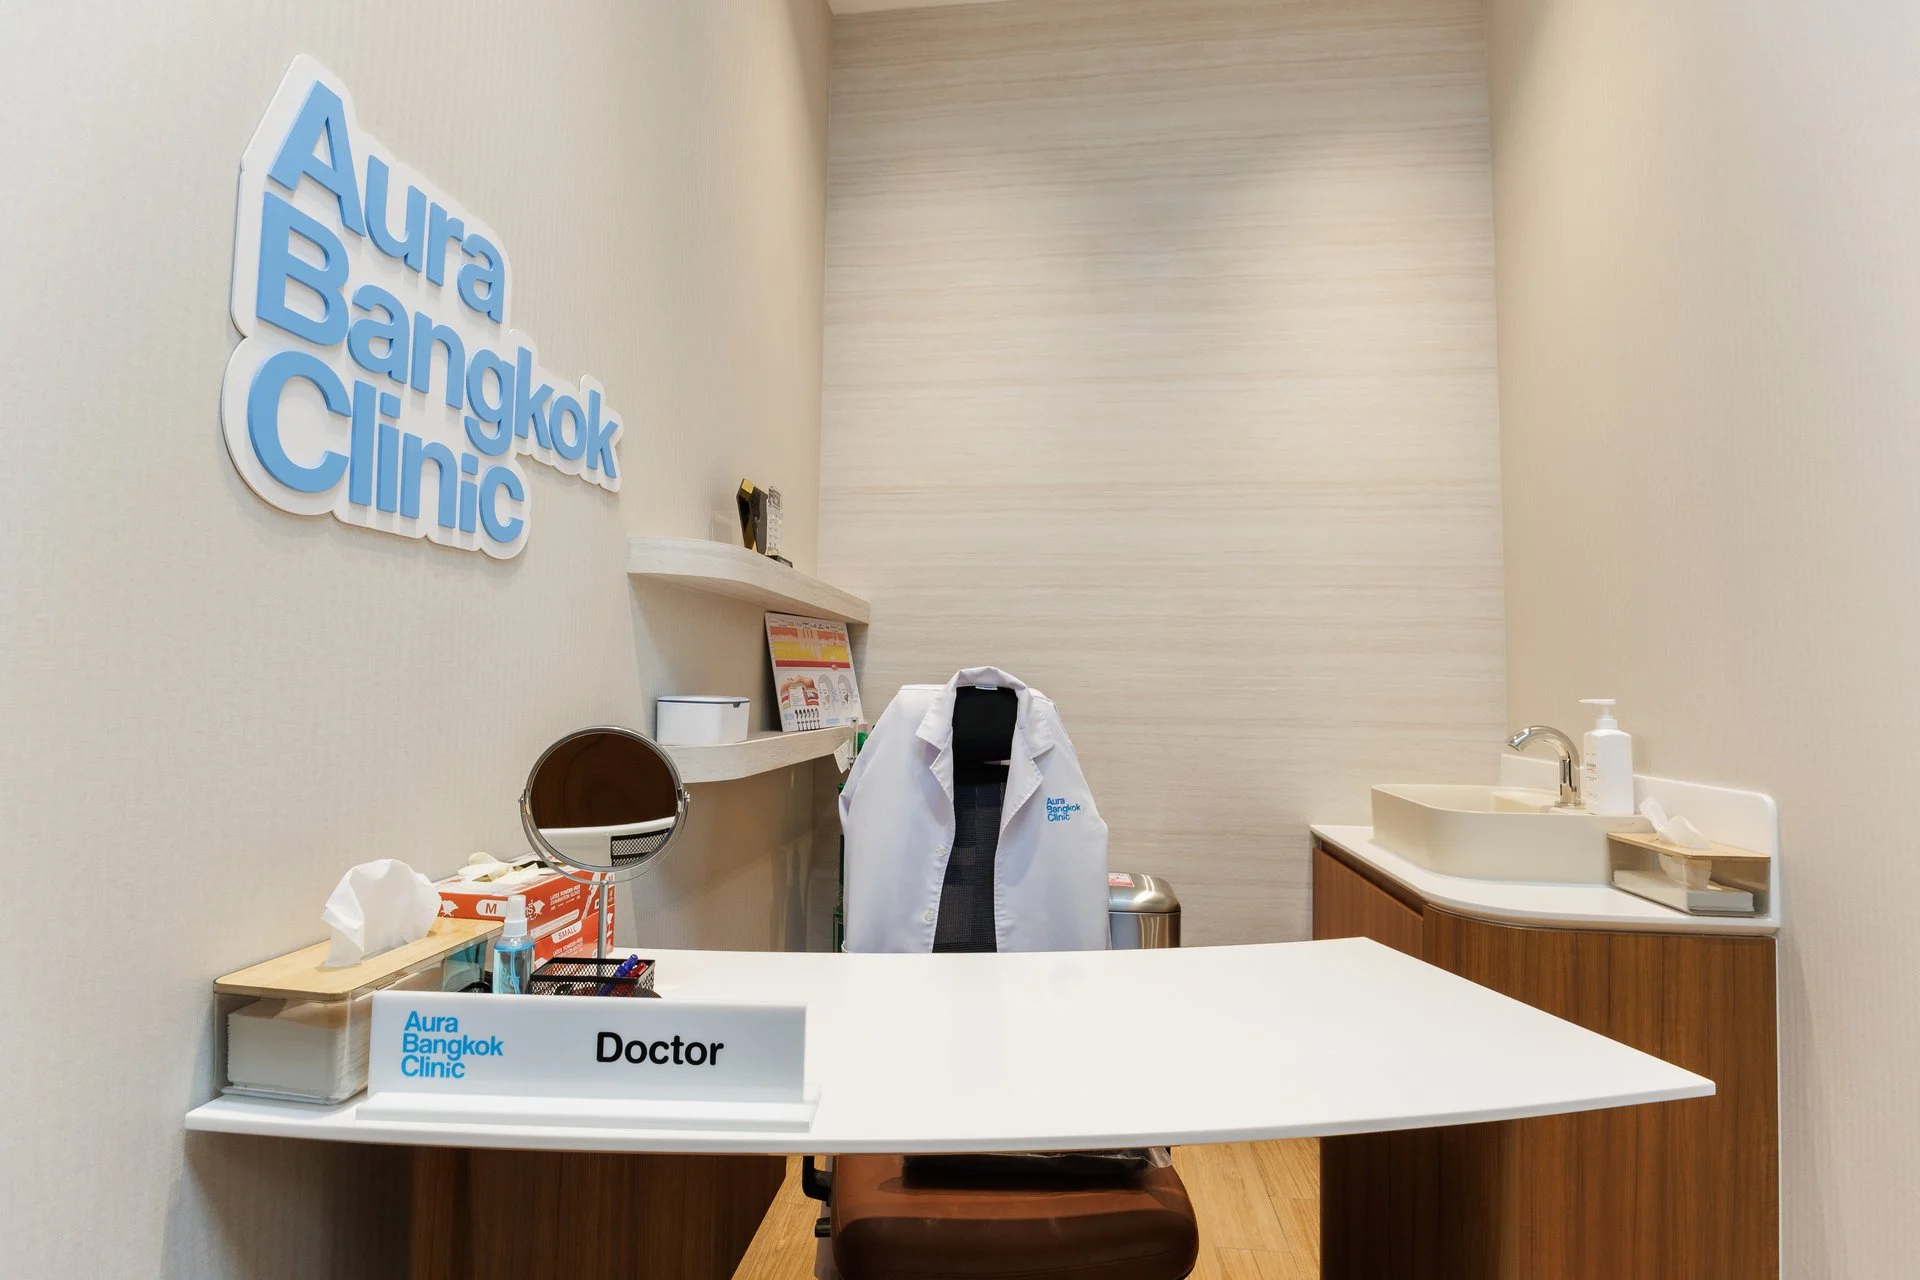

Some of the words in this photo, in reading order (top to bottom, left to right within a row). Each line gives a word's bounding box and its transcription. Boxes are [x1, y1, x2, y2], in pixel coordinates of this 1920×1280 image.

[267, 79, 505, 324] Aura
[256, 191, 619, 481] Bangkok
[247, 350, 525, 543] Clinic
[1047, 797, 1065, 805] Aura
[1047, 804, 1081, 814] Bangkok
[1047, 813, 1071, 822] Clinic
[485, 902, 498, 915] M
[558, 925, 577, 940] SMALL
[404, 1010, 459, 1033] Aura
[402, 1032, 505, 1061] Bangkok
[596, 1031, 725, 1066] Doctor
[400, 1054, 466, 1079] Clinic
